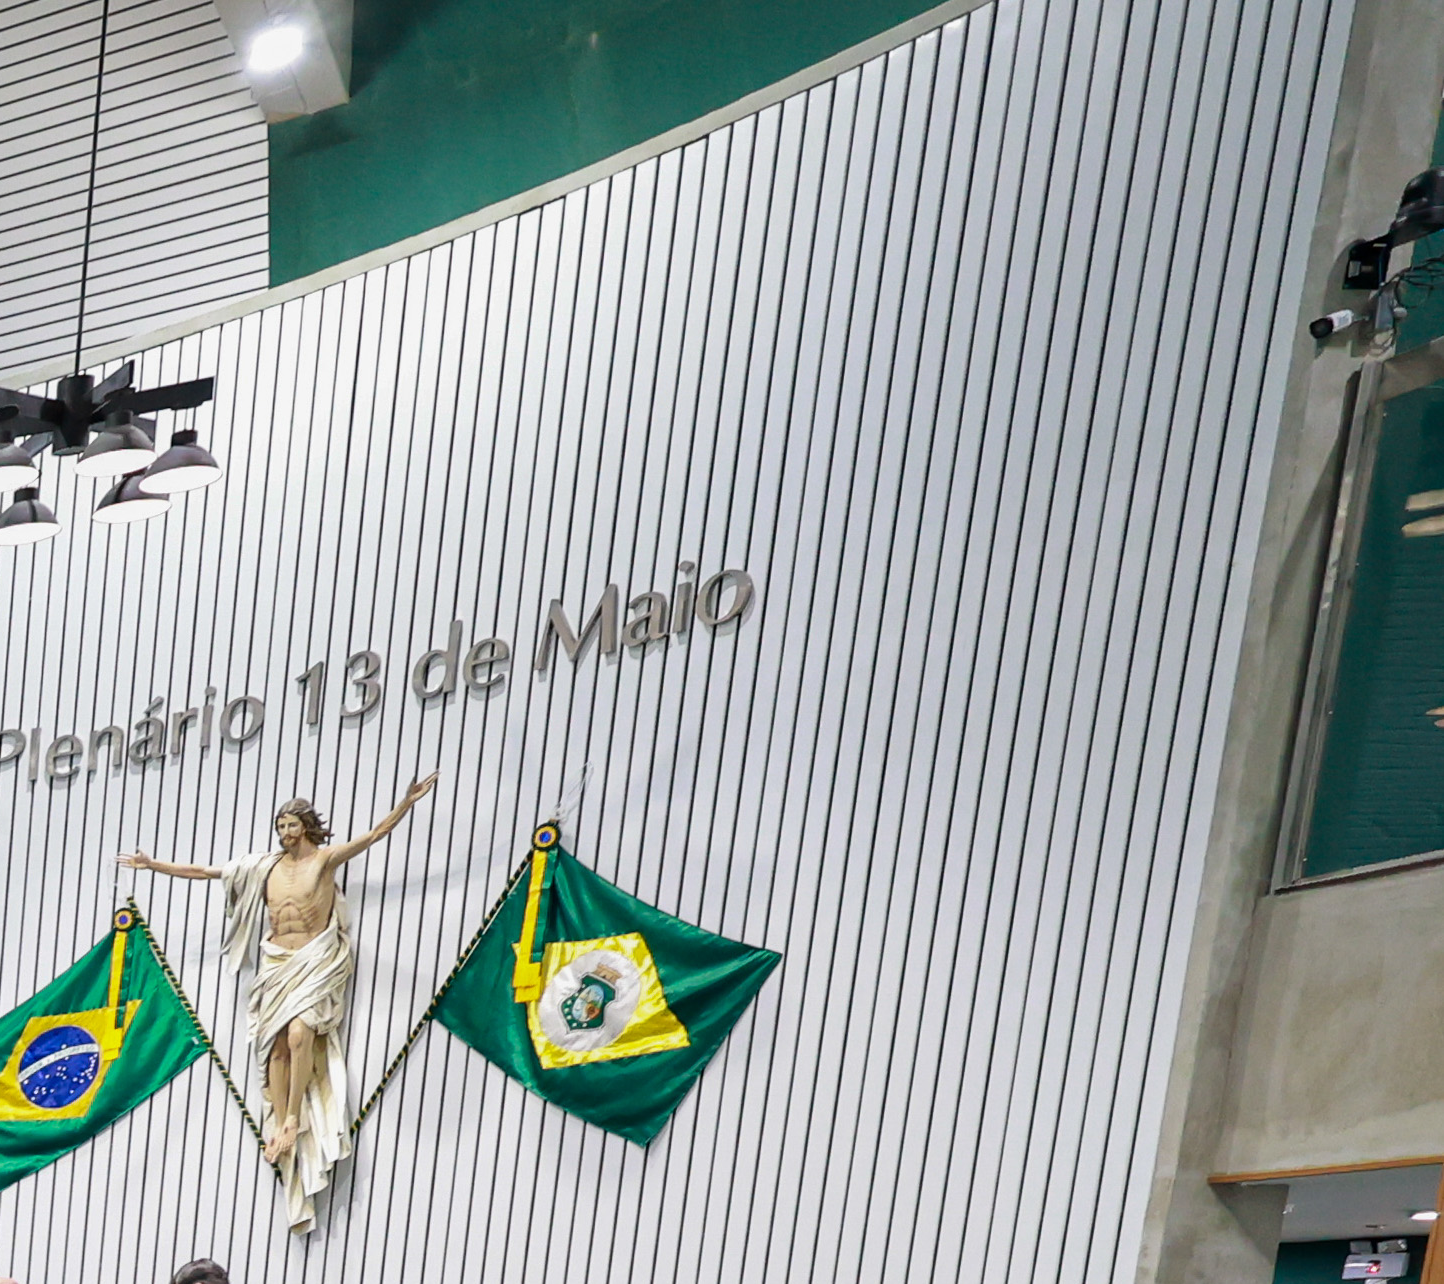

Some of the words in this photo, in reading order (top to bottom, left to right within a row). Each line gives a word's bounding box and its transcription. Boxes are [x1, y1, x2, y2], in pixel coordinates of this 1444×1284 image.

[295, 648, 383, 726] 13
[411, 618, 511, 700] de
[533, 560, 757, 672] Maio
